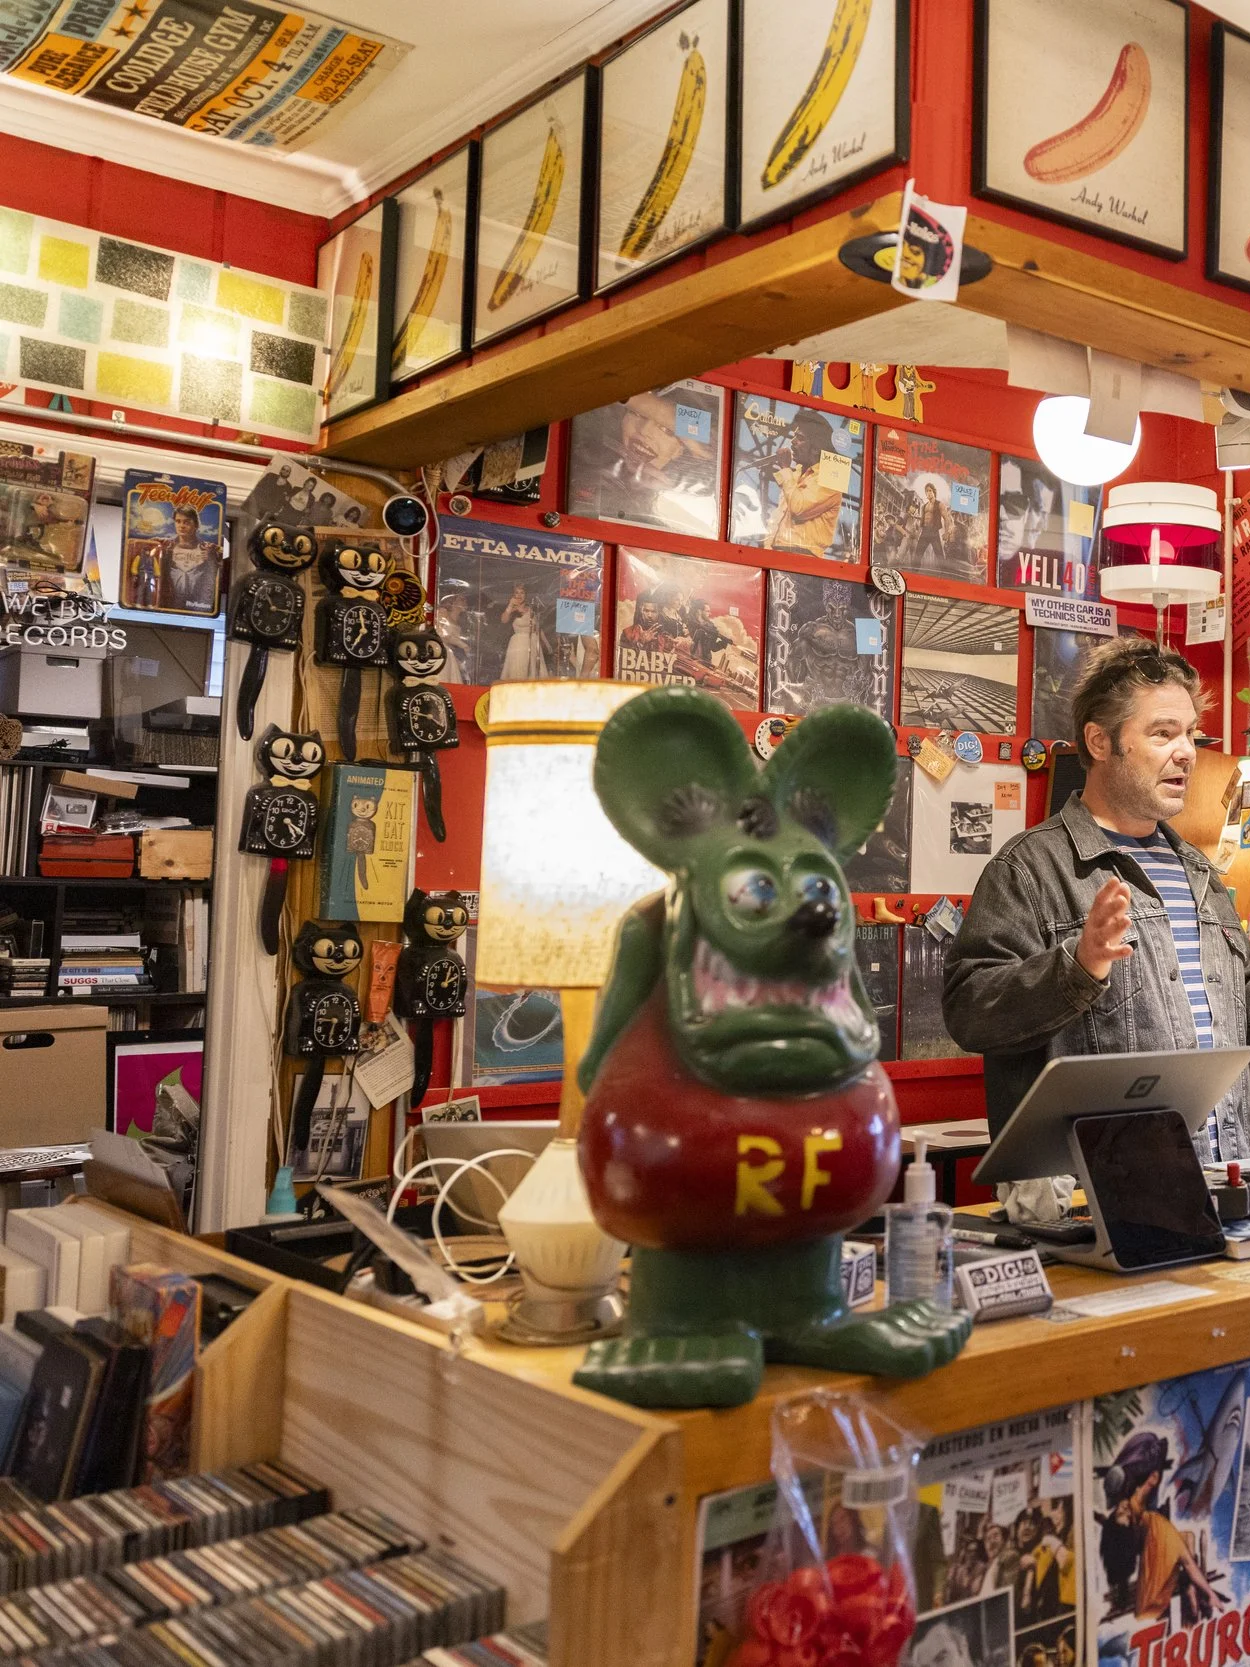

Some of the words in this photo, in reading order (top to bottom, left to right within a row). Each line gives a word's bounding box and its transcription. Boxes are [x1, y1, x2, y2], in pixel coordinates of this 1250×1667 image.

[105, 16, 195, 94] COOLIDGE
[134, 48, 227, 119] FIELDHOUSE
[203, 6, 257, 51] GYM
[223, 75, 279, 110] OCT.
[261, 58, 294, 73] 4
[313, 54, 346, 87] CHARGE
[314, 39, 378, 102] 202-432-SEAT
[802, 157, 829, 182] Andy
[831, 133, 866, 165] Warhol
[1071, 187, 1104, 213] Andy
[1109, 199, 1149, 226] Warhol
[136, 483, 174, 505] Teen
[173, 485, 216, 512] Wolf
[443, 533, 512, 557] ETTA
[514, 545, 598, 569] JAMES
[2, 592, 49, 618] WE
[60, 598, 117, 624] BUY
[908, 592, 949, 604] QUATERMASS
[1031, 598, 1044, 608] MY
[1046, 600, 1075, 613] OTHER
[1076, 604, 1094, 615] CAR
[1095, 607, 1104, 617] IS
[1105, 608, 1112, 618] A
[1033, 608, 1075, 623] TECHNICS
[1076, 615, 1111, 627] SL-1200
[0, 622, 127, 650] ECORDS
[621, 648, 678, 673] BABY
[620, 669, 697, 687] DRIVER
[957, 740, 978, 751] DIG!
[346, 775, 385, 786] ANIMATED
[384, 801, 406, 821] KIT
[383, 821, 405, 840] CAT
[63, 977, 98, 985] SUGGS
[735, 1134, 843, 1216] RF
